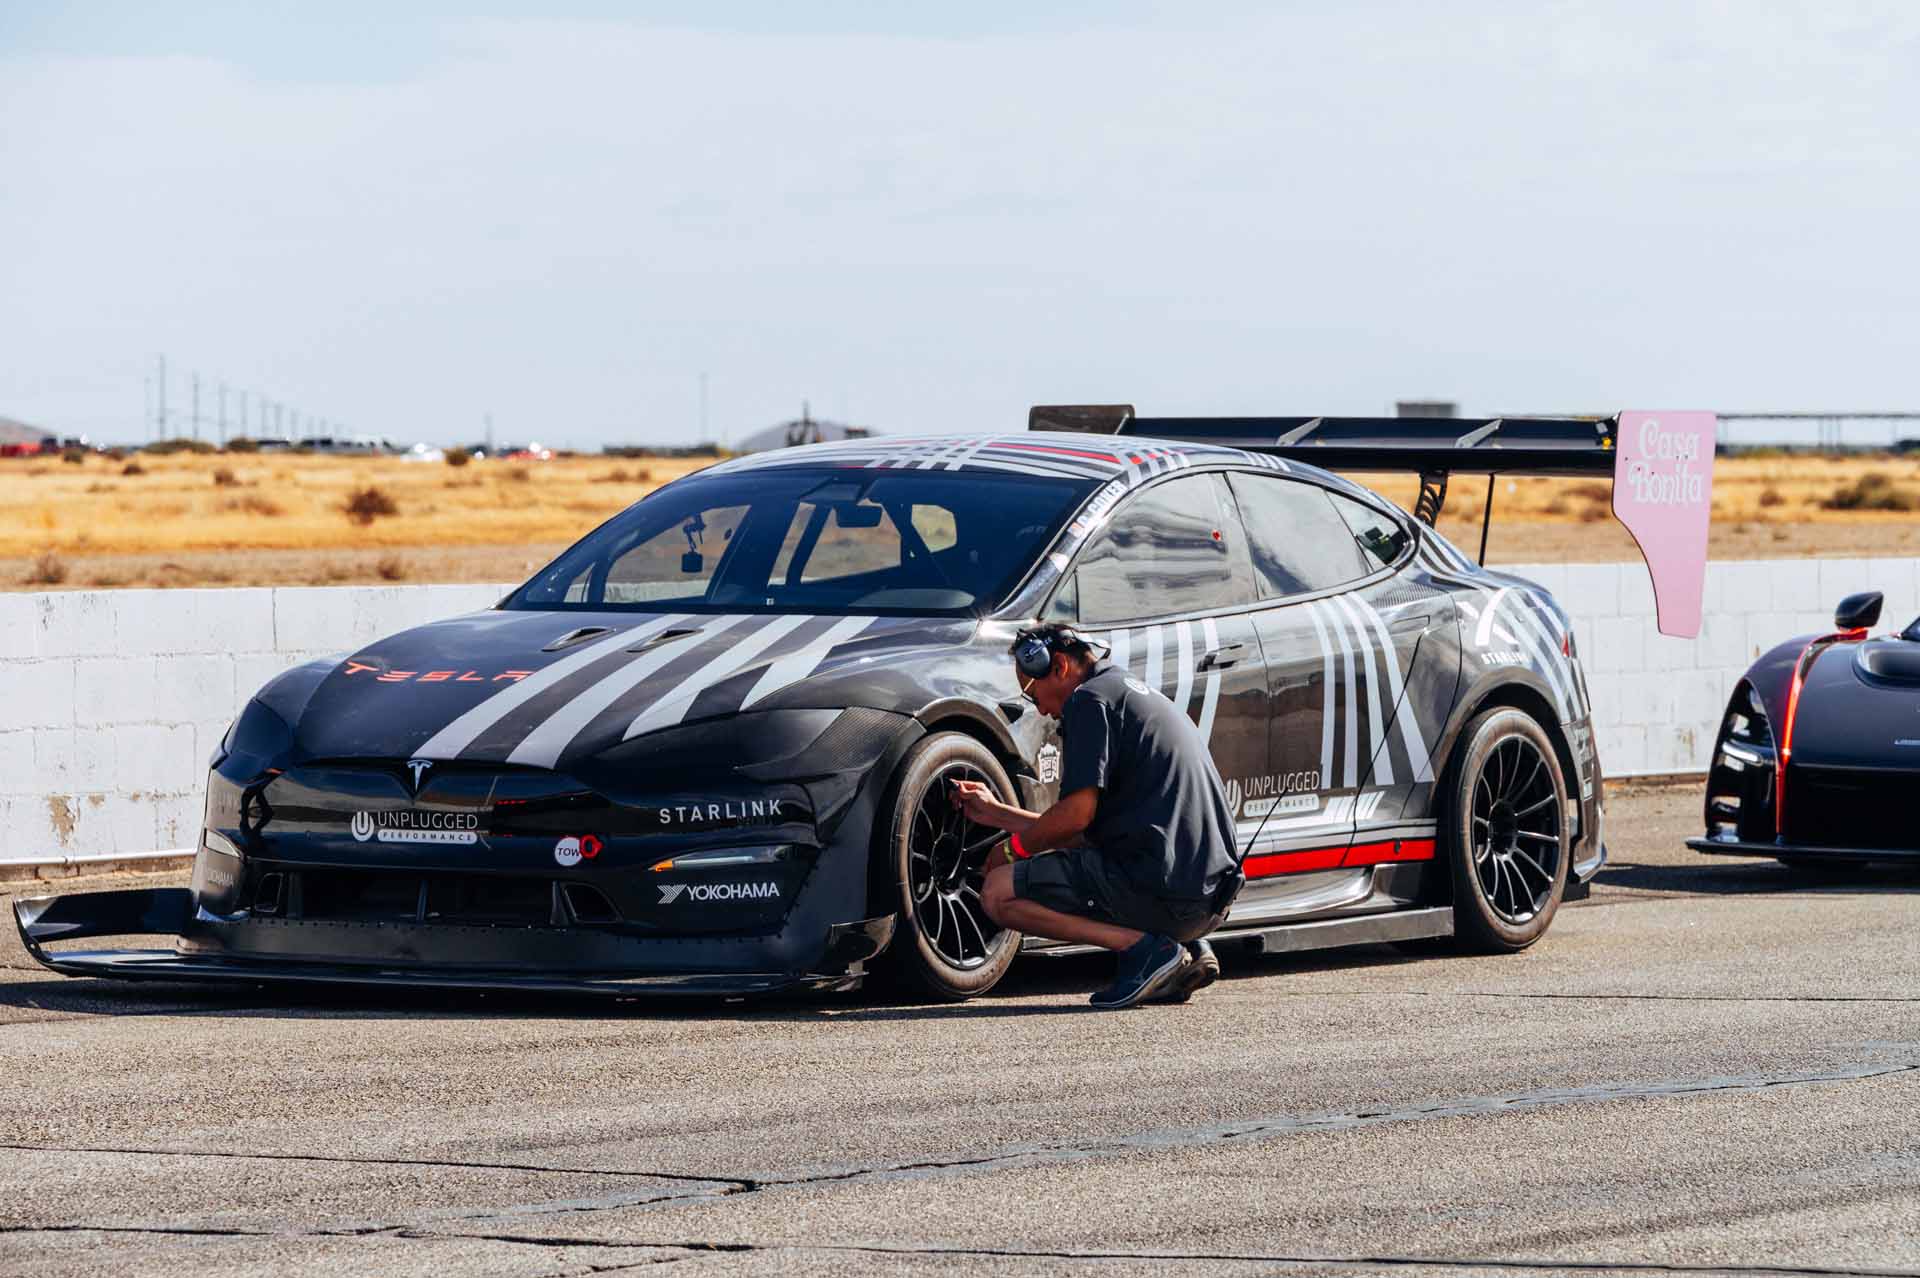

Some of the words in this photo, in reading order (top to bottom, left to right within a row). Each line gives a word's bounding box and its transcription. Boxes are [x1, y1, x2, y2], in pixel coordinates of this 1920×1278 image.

[1638, 417, 1701, 460] Casa
[1627, 461, 1704, 508] Bonita
[345, 660, 535, 683] TESLA
[1244, 770, 1320, 798] UNPLUGGED
[377, 811, 478, 830] UNPLUGGED
[659, 799, 782, 824] STARLINK
[382, 830, 473, 842] PERFORMANCE
[557, 847, 580, 857] TOW
[687, 882, 780, 900] YOKOHAMA
